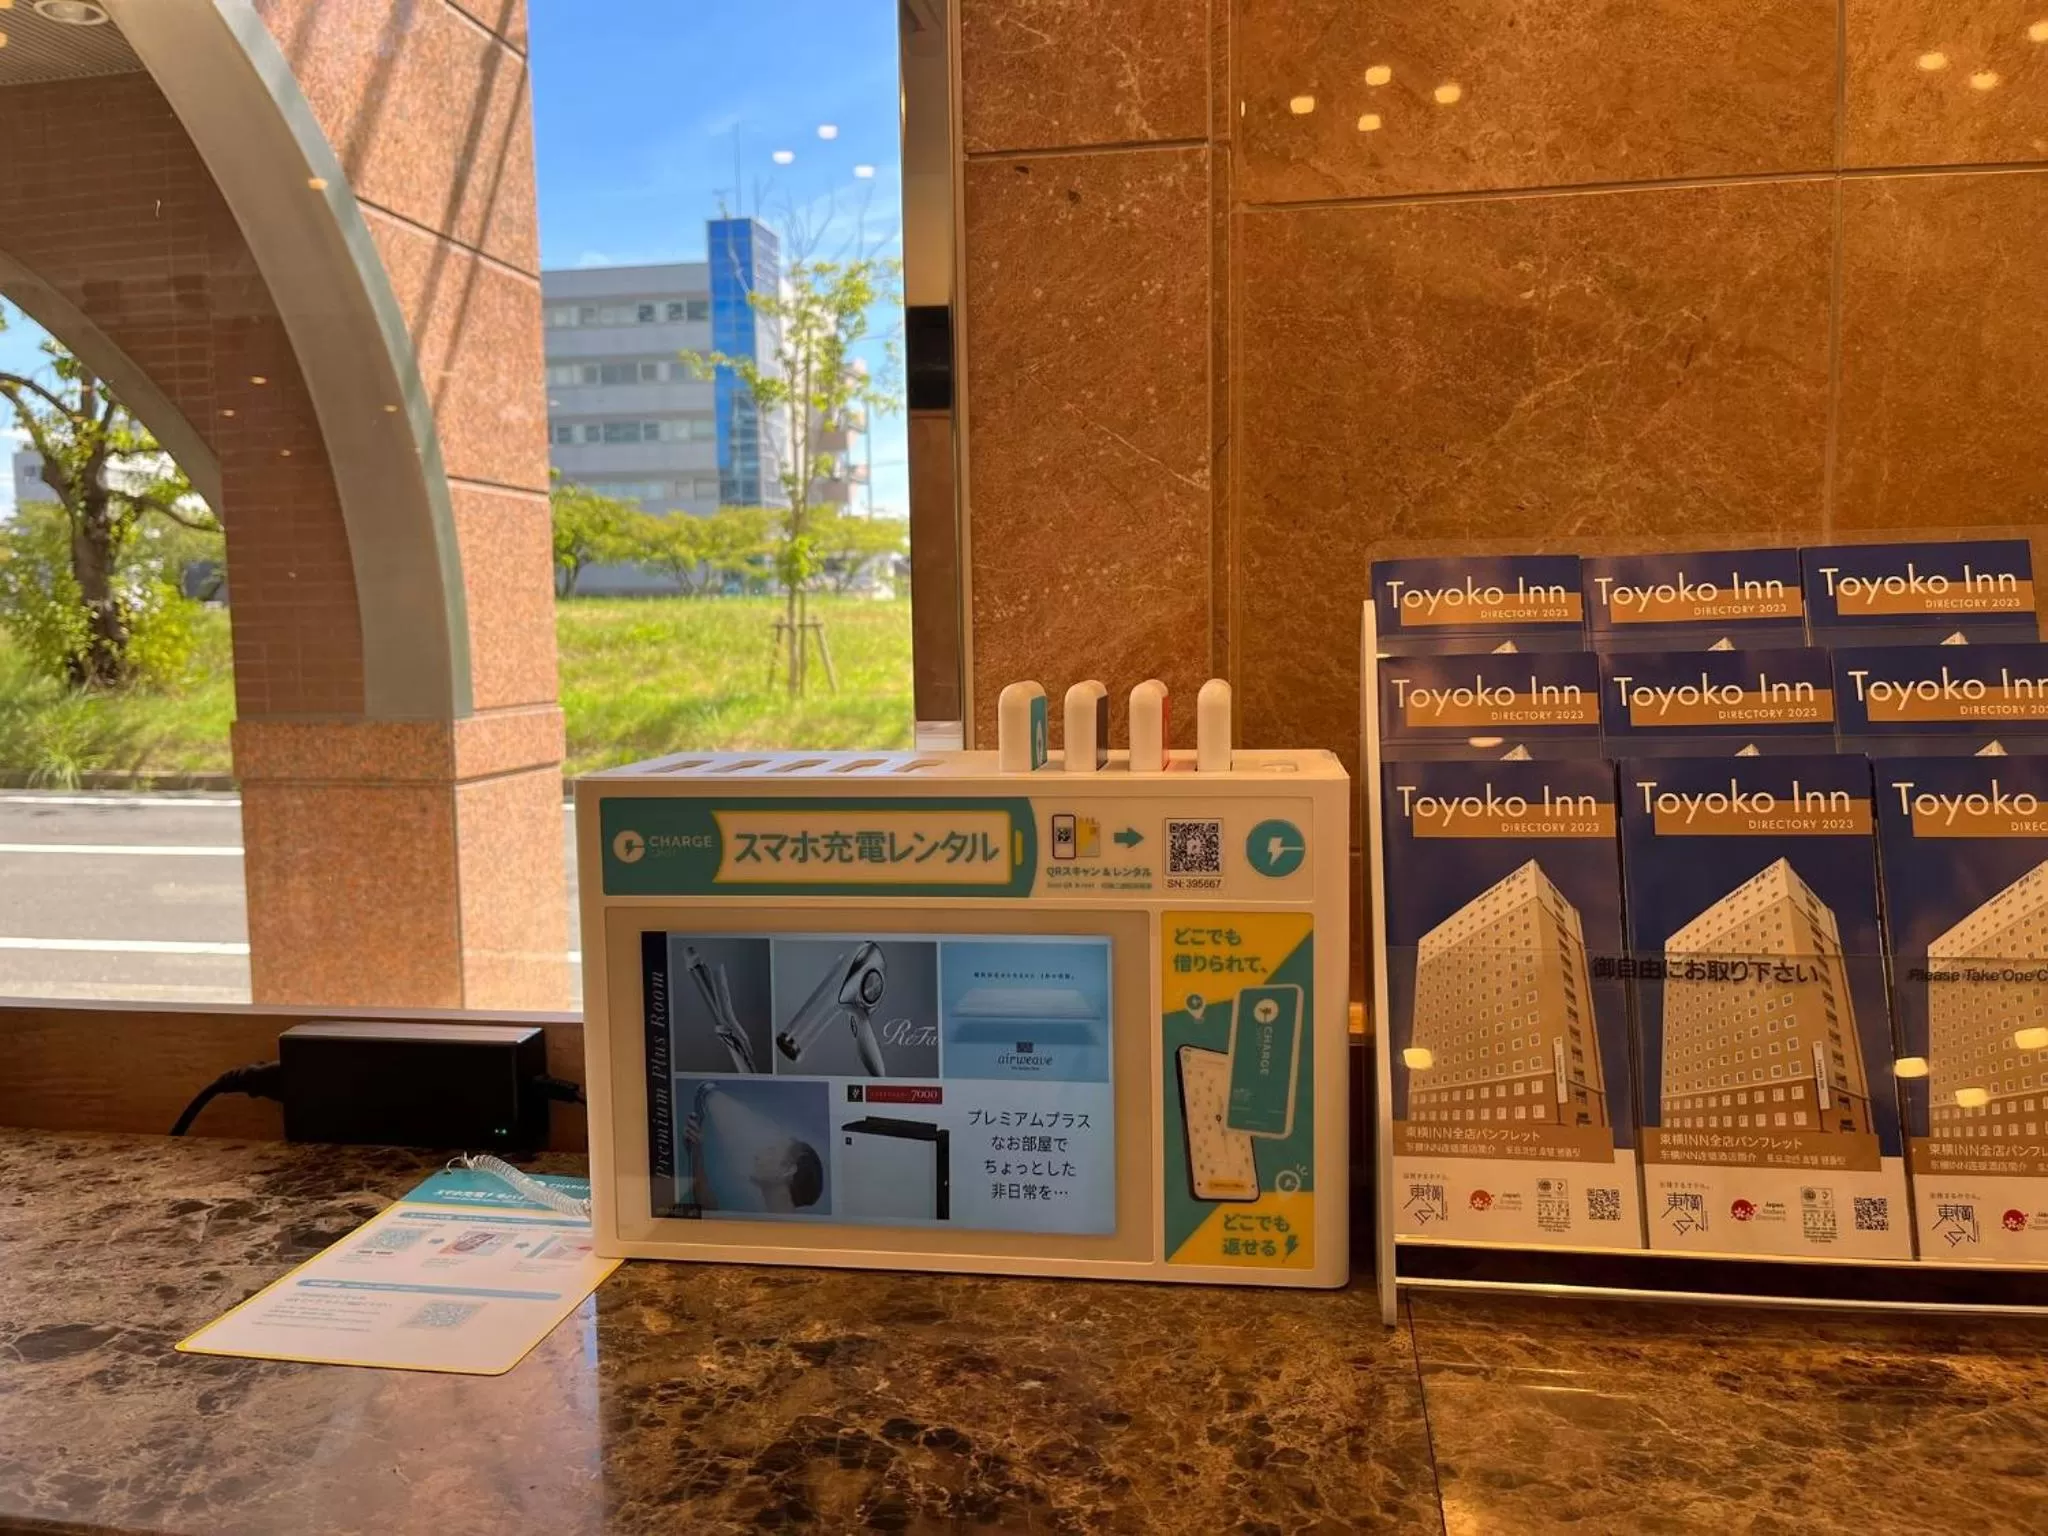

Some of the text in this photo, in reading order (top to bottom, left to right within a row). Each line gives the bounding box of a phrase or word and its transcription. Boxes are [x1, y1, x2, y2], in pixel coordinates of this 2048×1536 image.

[1594, 572, 1785, 613] Toyoko Inn
[1818, 563, 2017, 605] Toyoko Inn
[1386, 576, 1566, 616] Toyoko Inn
[1925, 598, 2021, 609] DIRECTORY 2023
[1480, 608, 1569, 619] DIRECTORY 2023
[1694, 603, 1787, 616] DIRECTORY 2023
[1391, 674, 1581, 717] Toyoko Inn
[1613, 672, 1814, 716] Toyoko Inn
[1847, 666, 1986, 711] Toyoko
[1491, 710, 1585, 720] DIRECTORY 2023
[1718, 708, 1817, 719] DIRECTORY 2023
[1960, 705, 2026, 716] DIRECTORY
[1396, 783, 1597, 827] Toyoko Inn
[1636, 778, 1850, 824] Toyoko Inn
[1892, 779, 2038, 826] Toyoko
[1501, 822, 1600, 833] DIRECTORY 2023
[1748, 819, 1854, 830] DIRECTORY 2023
[650, 836, 713, 848] CHARGE
[734, 830, 999, 863] スマホ充電レンタル
[1167, 879, 1222, 889] SN: 395667
[1174, 928, 1242, 946] どこでも
[1592, 957, 1820, 983] 御自由にお取り下さい
[1964, 968, 1999, 981] Take
[997, 1052, 1053, 1066] airweave
[1260, 1026, 1273, 1076] CHARGE
[650, 971, 671, 1180] Premium Plus Room
[911, 1089, 938, 1101] 7000
[968, 1110, 1091, 1129] プレミアムプラス
[991, 1135, 1068, 1152] なお部屋で
[1659, 1133, 1803, 1149] 東横INN全店パンフレット
[984, 1159, 1077, 1177] ちょっとした
[1223, 1214, 1290, 1232] どこでも
[1223, 1237, 1277, 1257] 返せる
